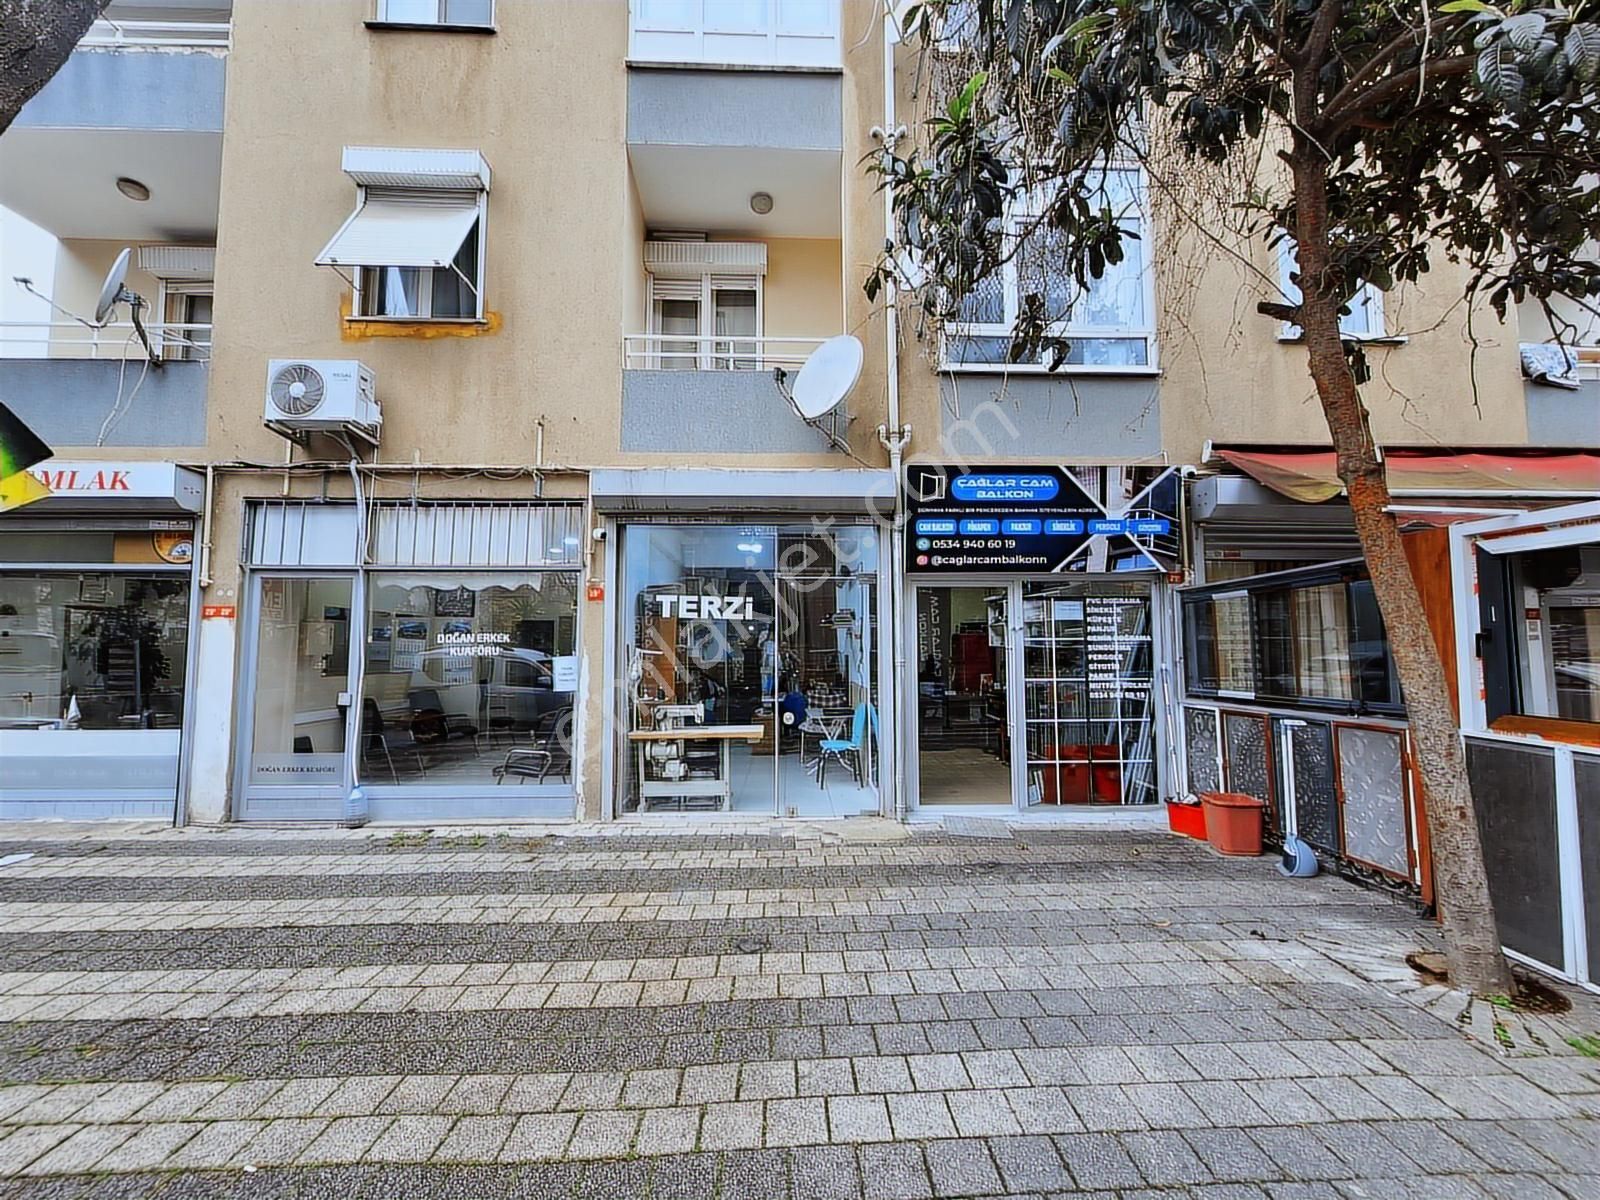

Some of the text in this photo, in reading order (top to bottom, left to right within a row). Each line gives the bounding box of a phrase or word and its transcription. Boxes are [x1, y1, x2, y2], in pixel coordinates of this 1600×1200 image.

[26, 470, 131, 491] MLAK
[957, 478, 1054, 489] ÇAĞLAR CAM
[976, 490, 1034, 499] BALKON
[932, 539, 1016, 549] 0534 940 60 19
[931, 554, 1047, 566] @caglarcambalkonn
[436, 631, 511, 644] DOĞAN ERKEK
